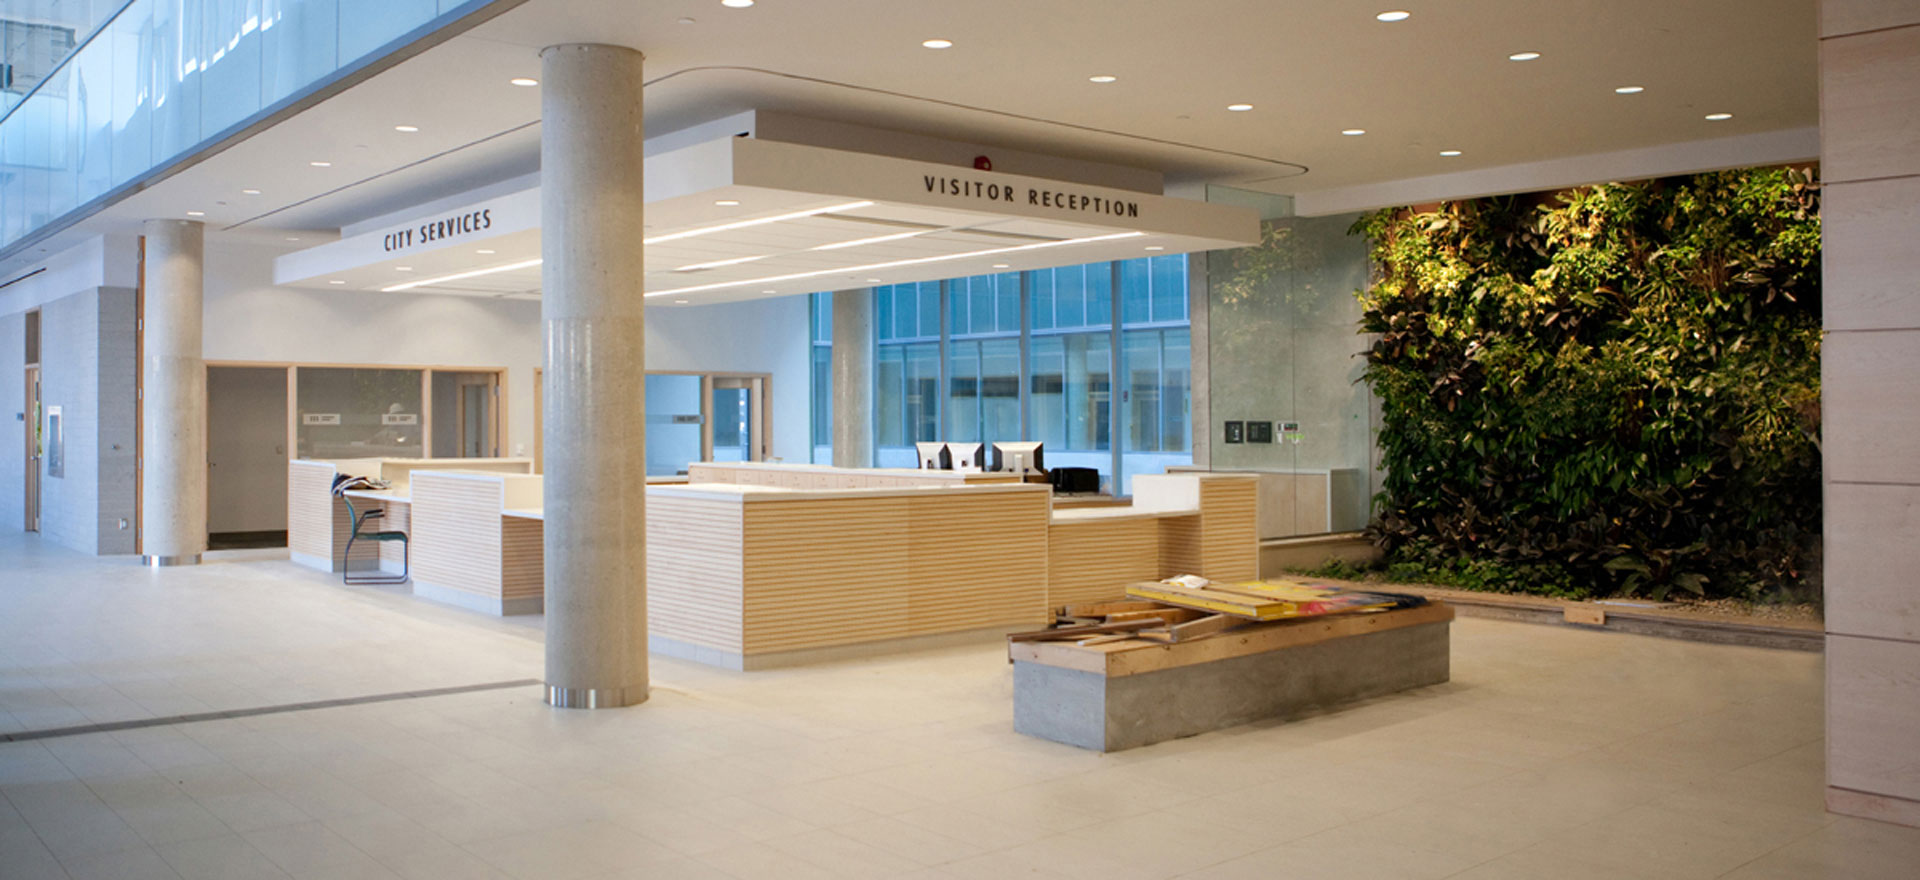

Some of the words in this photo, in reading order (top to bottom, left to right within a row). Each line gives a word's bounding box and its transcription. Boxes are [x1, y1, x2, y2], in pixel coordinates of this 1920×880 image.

[924, 175, 1014, 202] VISITOR
[1028, 189, 1138, 217] RECEPTION
[384, 229, 412, 251] CITY
[420, 209, 491, 243] SERVICES
